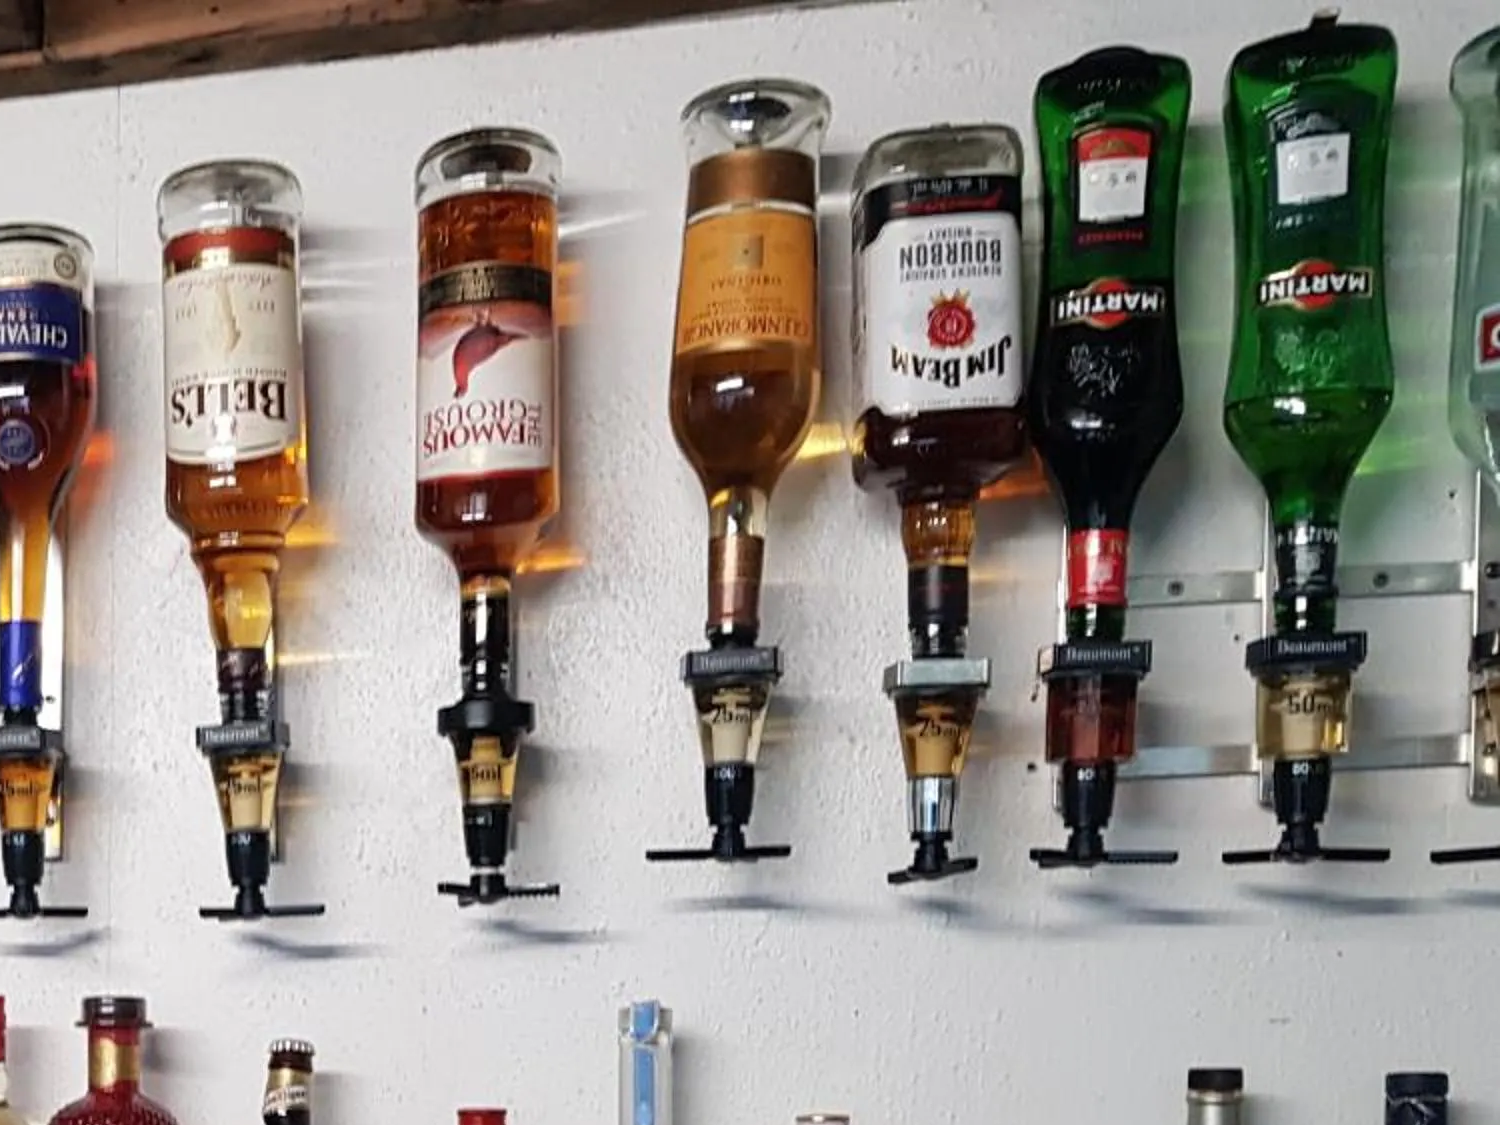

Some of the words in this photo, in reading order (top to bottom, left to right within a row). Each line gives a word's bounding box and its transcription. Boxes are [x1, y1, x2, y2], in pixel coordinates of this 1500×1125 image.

[900, 239, 1002, 267] BOURBON
[1058, 291, 1159, 320] MARTINI
[1260, 273, 1366, 303] MARTINI
[890, 345, 961, 389] BEAM
[966, 334, 1012, 378] JIM
[171, 380, 287, 428] BELL'S
[423, 400, 528, 437] GROUSE
[423, 421, 526, 458] FAMOUS
[527, 403, 543, 448] THE
[1066, 646, 1132, 660] Beaumont
[1278, 640, 1347, 655] Beaumont
